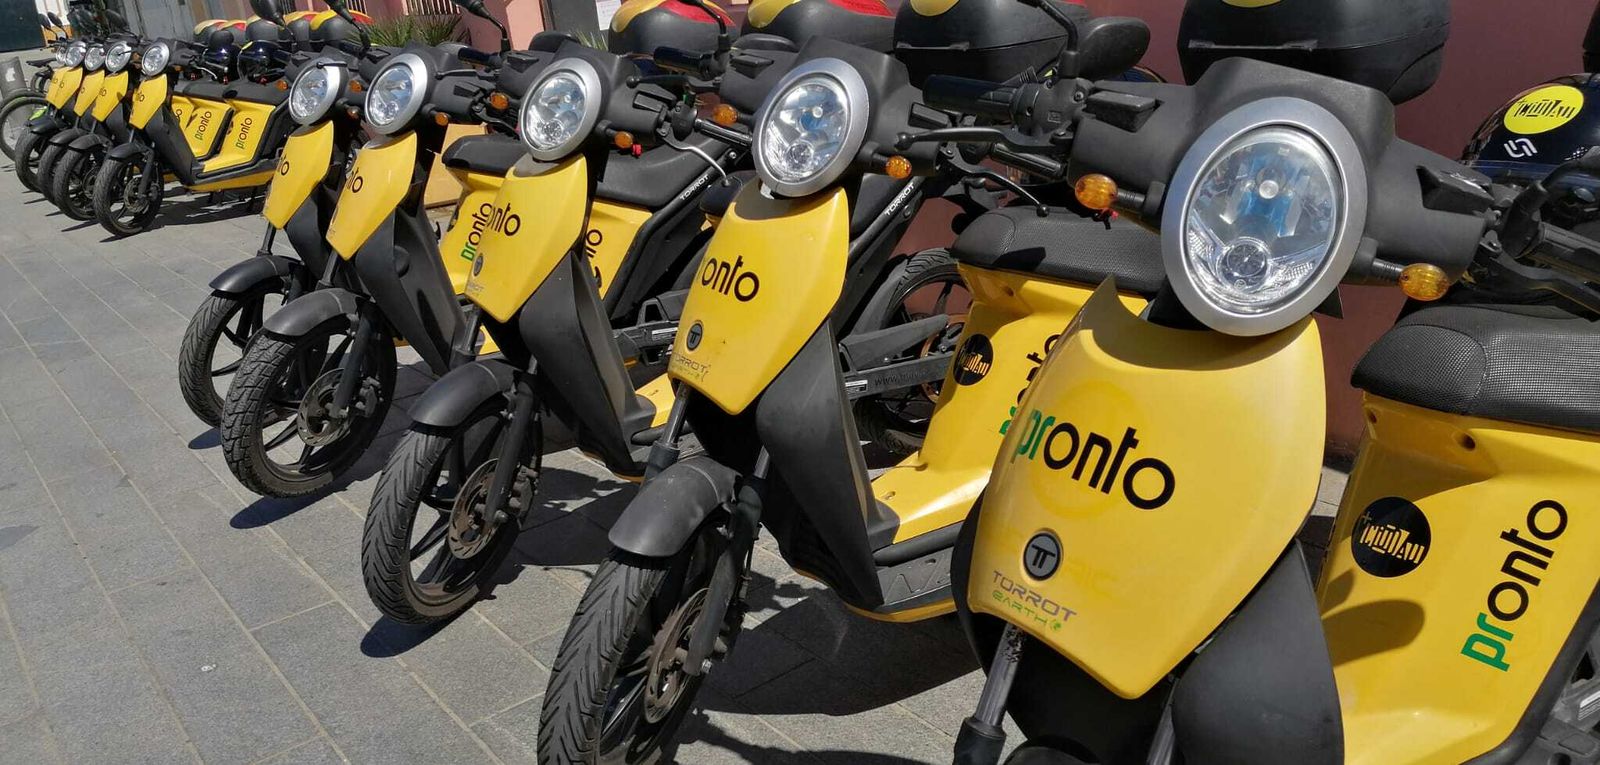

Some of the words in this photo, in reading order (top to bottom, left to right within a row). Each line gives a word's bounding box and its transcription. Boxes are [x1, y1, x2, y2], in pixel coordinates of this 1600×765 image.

[194, 111, 212, 140] pronto
[235, 117, 253, 149] pronto
[679, 174, 709, 201] TORROT
[884, 182, 915, 216] TORROT
[701, 255, 760, 302] onto
[1010, 409, 1175, 510] pronto
[992, 570, 1077, 622] TORROT
[1460, 500, 1568, 672] pronto
[991, 591, 1048, 626] EARTH
